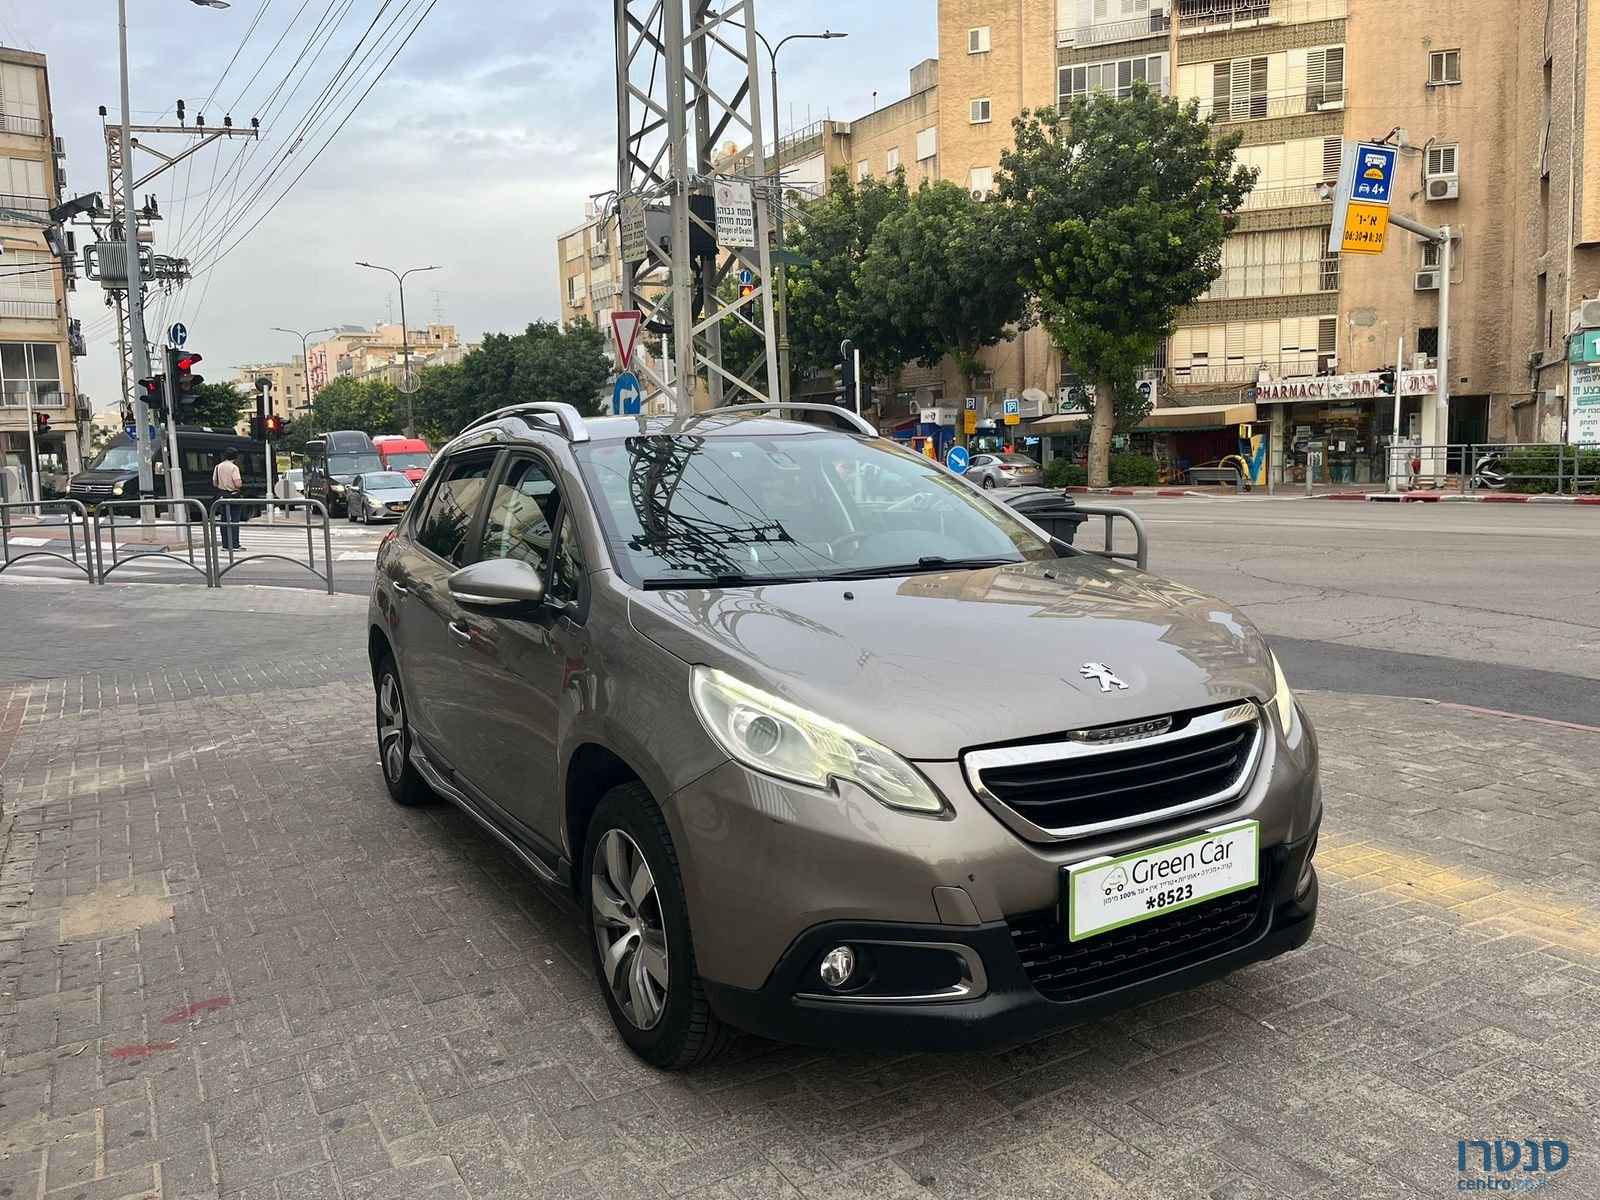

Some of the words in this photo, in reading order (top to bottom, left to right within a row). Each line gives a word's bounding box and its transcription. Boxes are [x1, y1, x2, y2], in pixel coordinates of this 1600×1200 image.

[1371, 183, 1385, 195] 4+
[737, 208, 751, 217] מתח
[736, 217, 752, 226] סכנת
[1256, 383, 1325, 400] PHARMACY
[1098, 721, 1162, 739] PEUGEOT
[1132, 852, 1195, 884] Green
[1200, 840, 1234, 865] Car
[1221, 862, 1233, 872] קניה
[1200, 867, 1217, 877] מכירה
[1119, 889, 1137, 901] 100%
